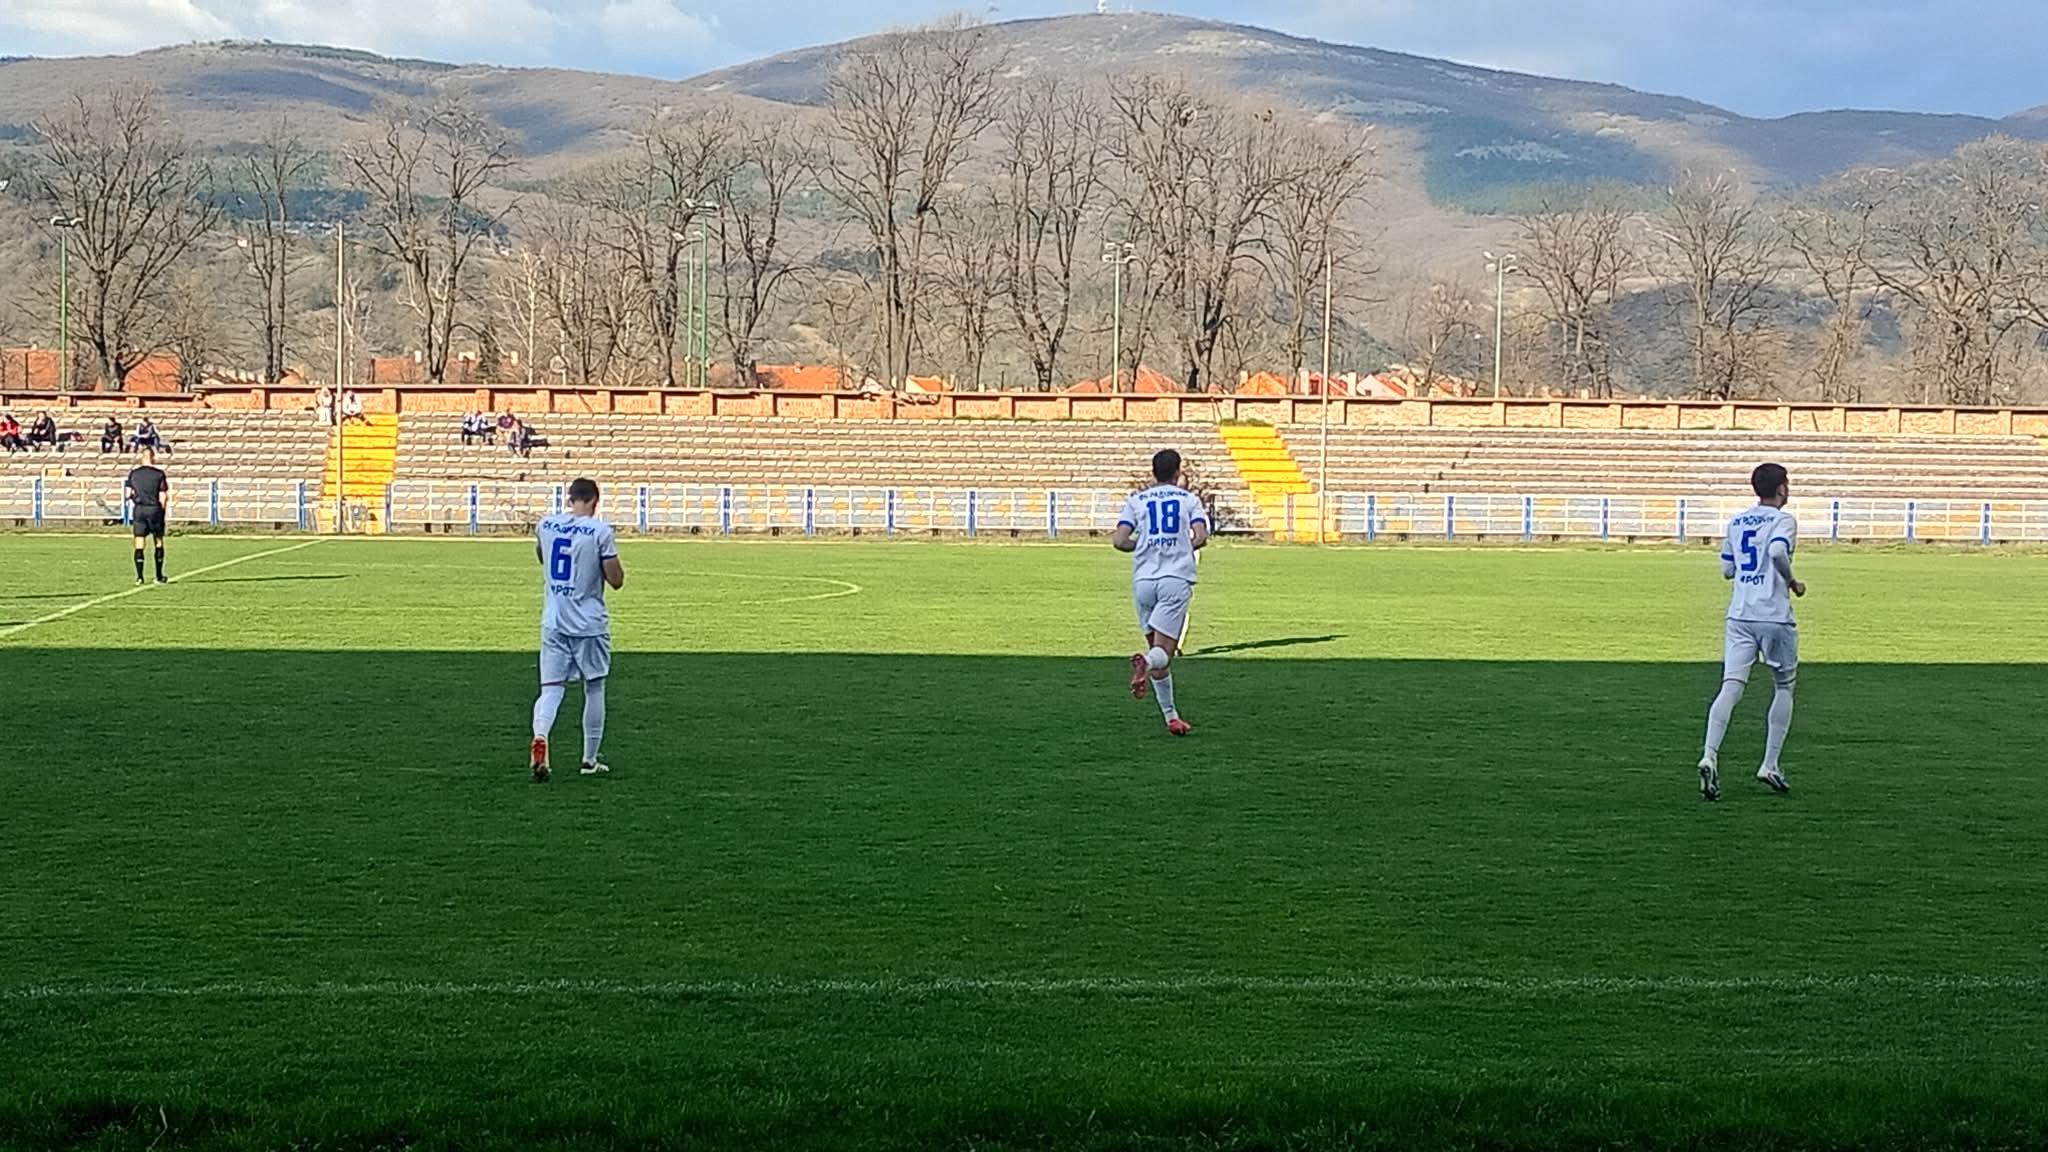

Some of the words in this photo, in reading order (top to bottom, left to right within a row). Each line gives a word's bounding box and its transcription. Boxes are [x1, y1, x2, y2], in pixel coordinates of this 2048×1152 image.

[1146, 499, 1180, 535] 18
[551, 537, 572, 581] 6
[1741, 530, 1757, 571] 5
